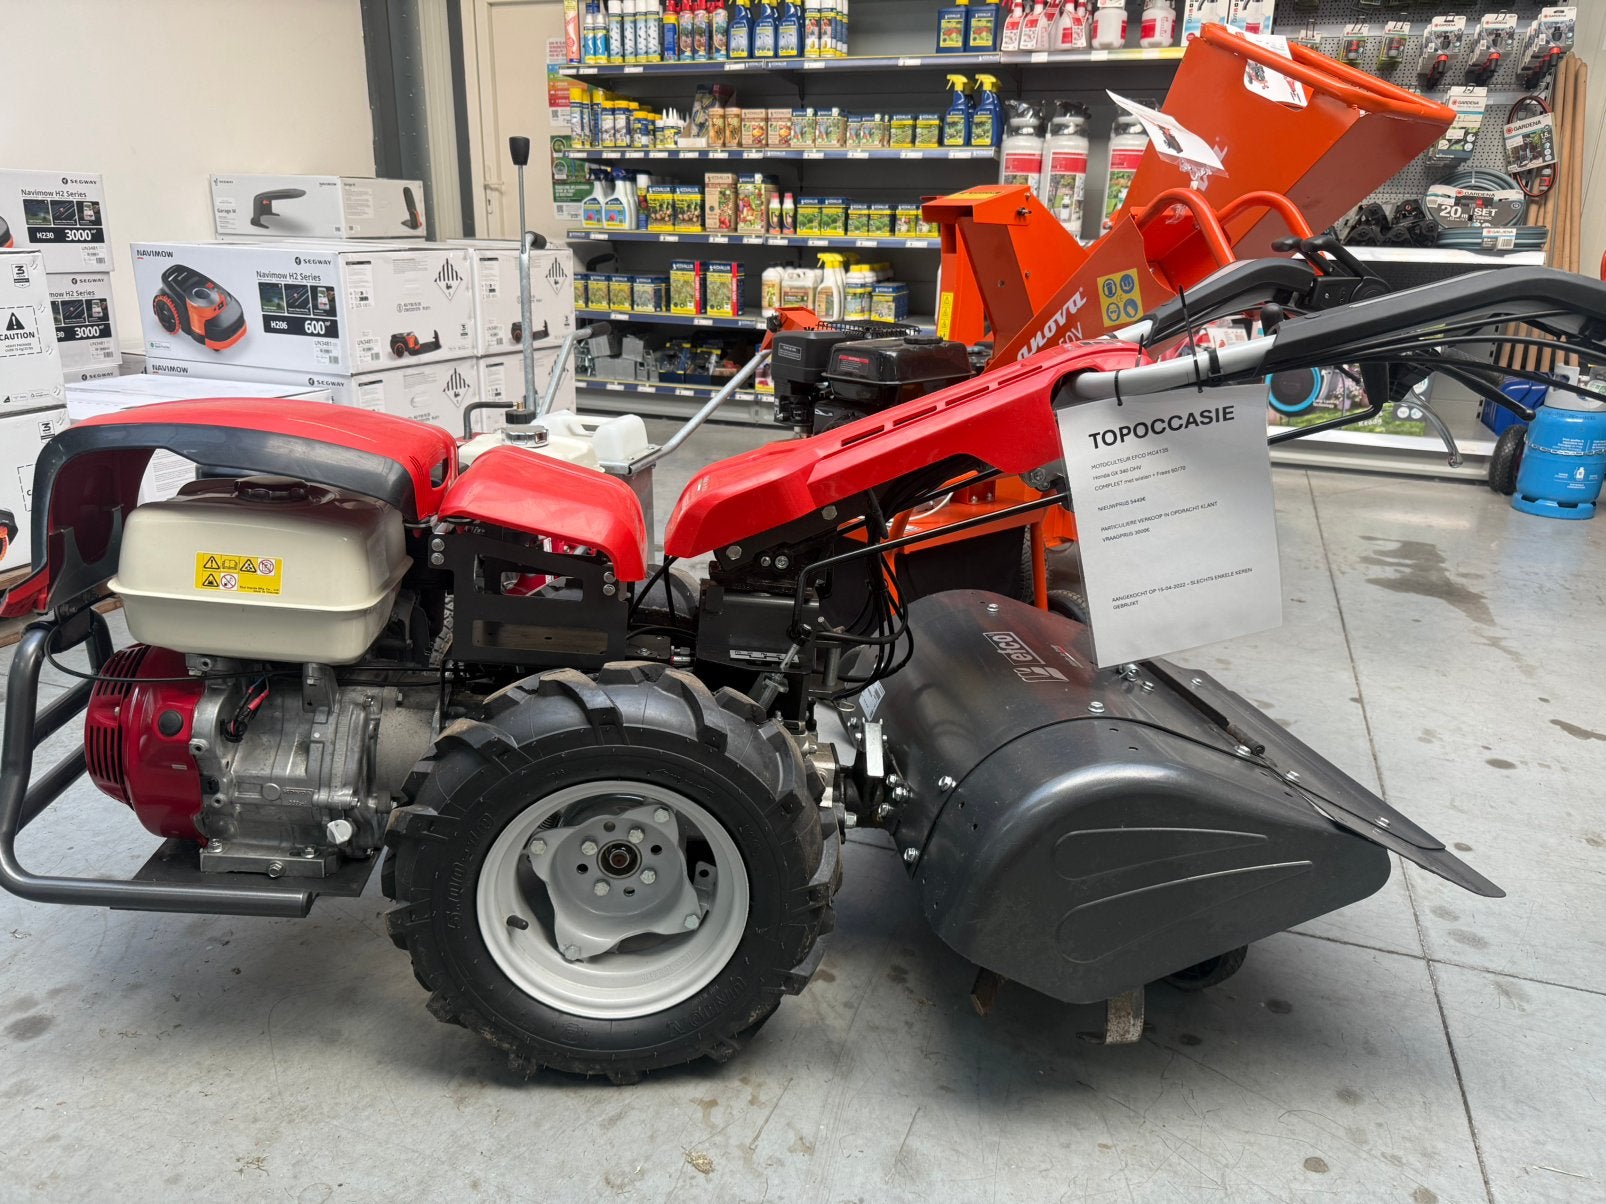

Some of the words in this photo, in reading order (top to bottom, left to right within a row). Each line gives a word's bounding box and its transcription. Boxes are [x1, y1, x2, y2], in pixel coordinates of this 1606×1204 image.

[1513, 119, 1542, 132] GARDENA
[20, 188, 54, 197] Navimow
[66, 190, 87, 198] Series
[1439, 205, 1462, 218] 20
[1473, 208, 1498, 217] SET
[36, 231, 54, 239] H230
[64, 229, 92, 241] 3000
[136, 249, 174, 258] NAVIMOW
[14, 265, 25, 275] 3
[256, 269, 287, 280] Navimow
[299, 273, 321, 282] Series
[74, 325, 100, 338] 3000
[270, 320, 288, 330] H206
[304, 320, 325, 334] 600
[152, 364, 189, 374] NAVIMOW
[316, 379, 345, 387] SEGWAY
[1088, 405, 1236, 450] TOPOCCASIE
[1091, 456, 1131, 471] MOTOCULTEUR
[1131, 452, 1147, 461] EFCO
[1093, 471, 1111, 481] Honda
[1094, 479, 1124, 491] COMPLEET
[1124, 477, 1134, 485] met
[1097, 499, 1130, 512] NIEUWPRIJS
[1100, 519, 1138, 532] PARTICULIERE
[1137, 513, 1164, 525] VERKOOP
[1170, 505, 1200, 516] OPDRACHT
[1200, 500, 1218, 510] KLANT
[1102, 530, 1134, 543] VRAAGPRIJS
[1112, 590, 1149, 603] AANGEKOCHT
[1190, 576, 1214, 586] SLECHTS
[1213, 571, 1235, 581] ENKELE
[1112, 600, 1140, 610] GEBRUIKT
[992, 634, 1033, 661] efco
